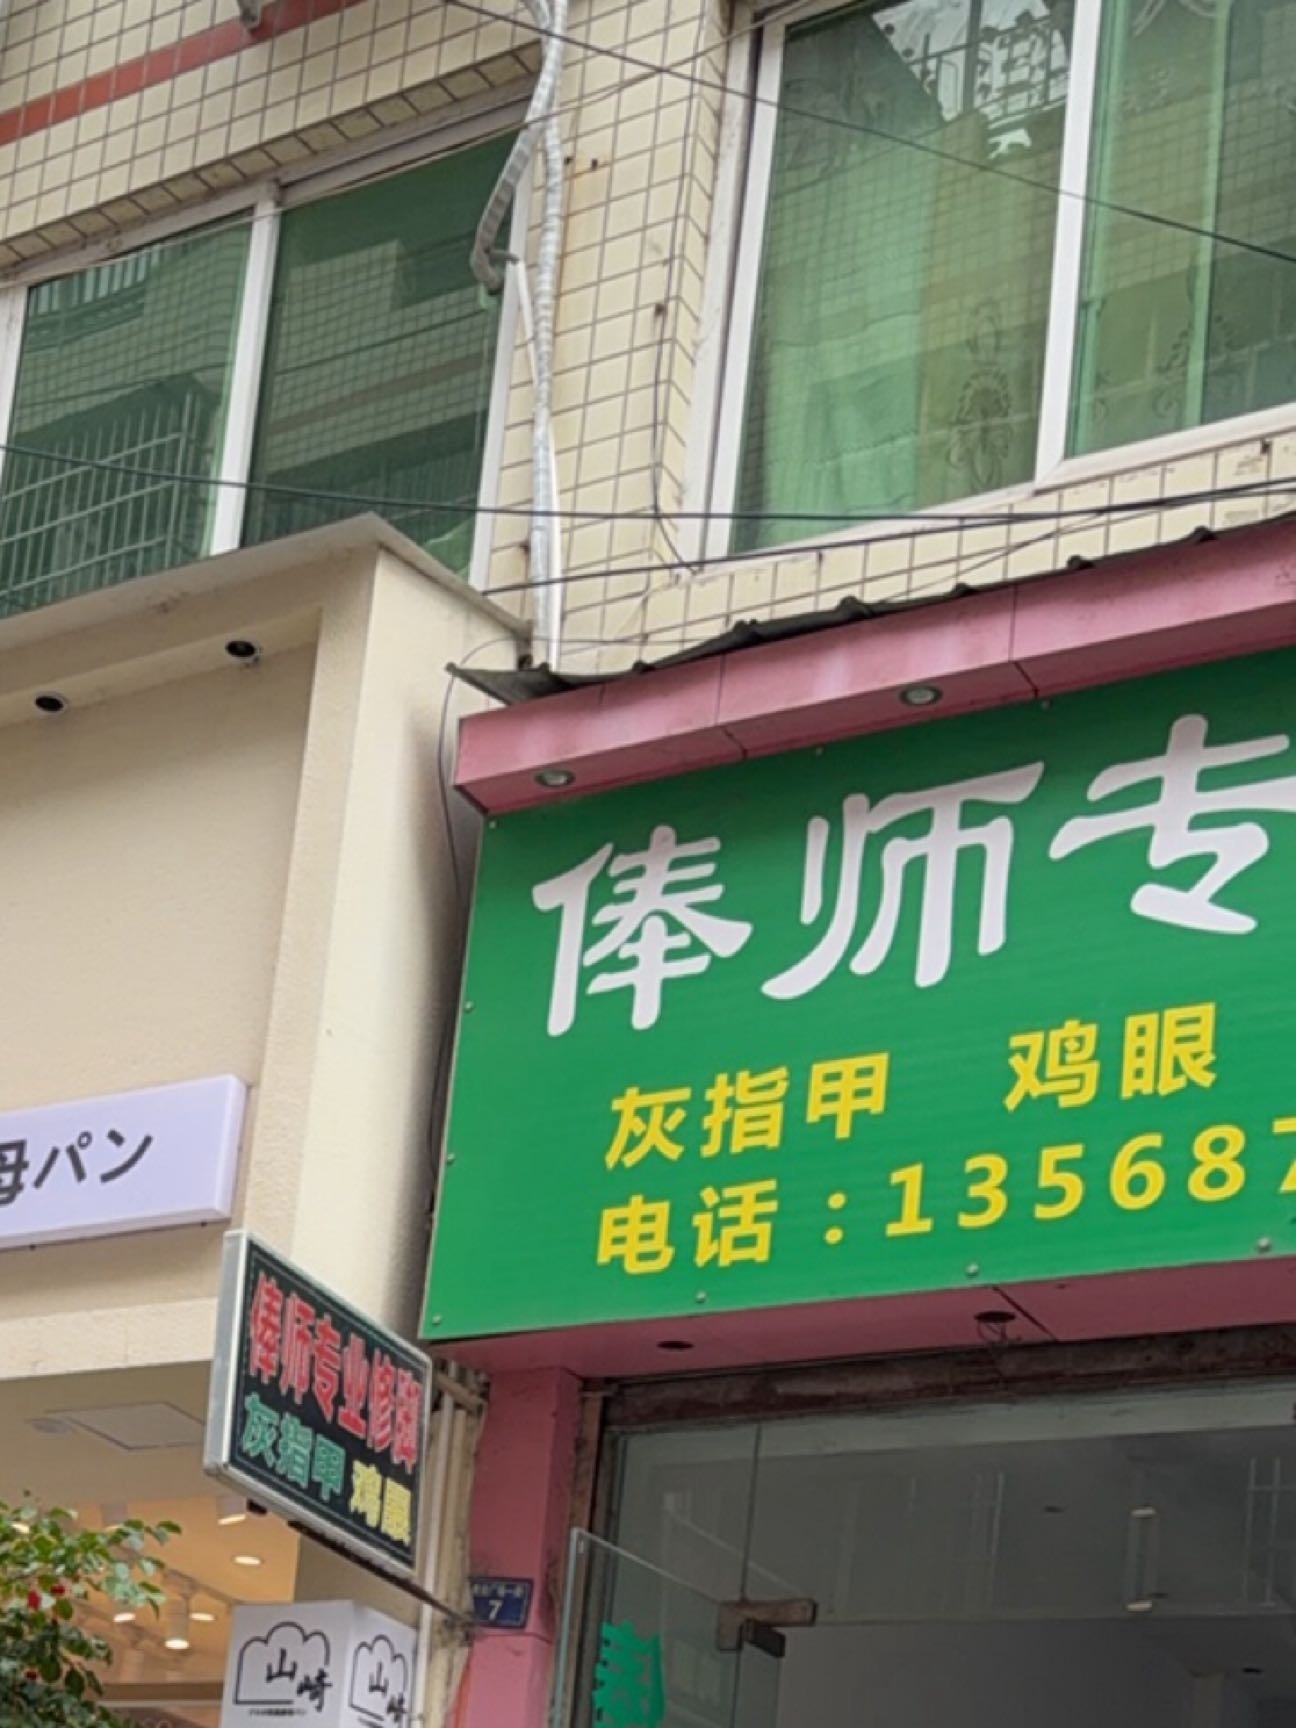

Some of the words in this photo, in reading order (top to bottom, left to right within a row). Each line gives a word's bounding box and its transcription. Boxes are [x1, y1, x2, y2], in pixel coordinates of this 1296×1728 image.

[605, 1051, 890, 1171] 灰指甲
[1004, 1003, 1218, 1112] 鸡眼
[488, 1599, 504, 1621] 7
